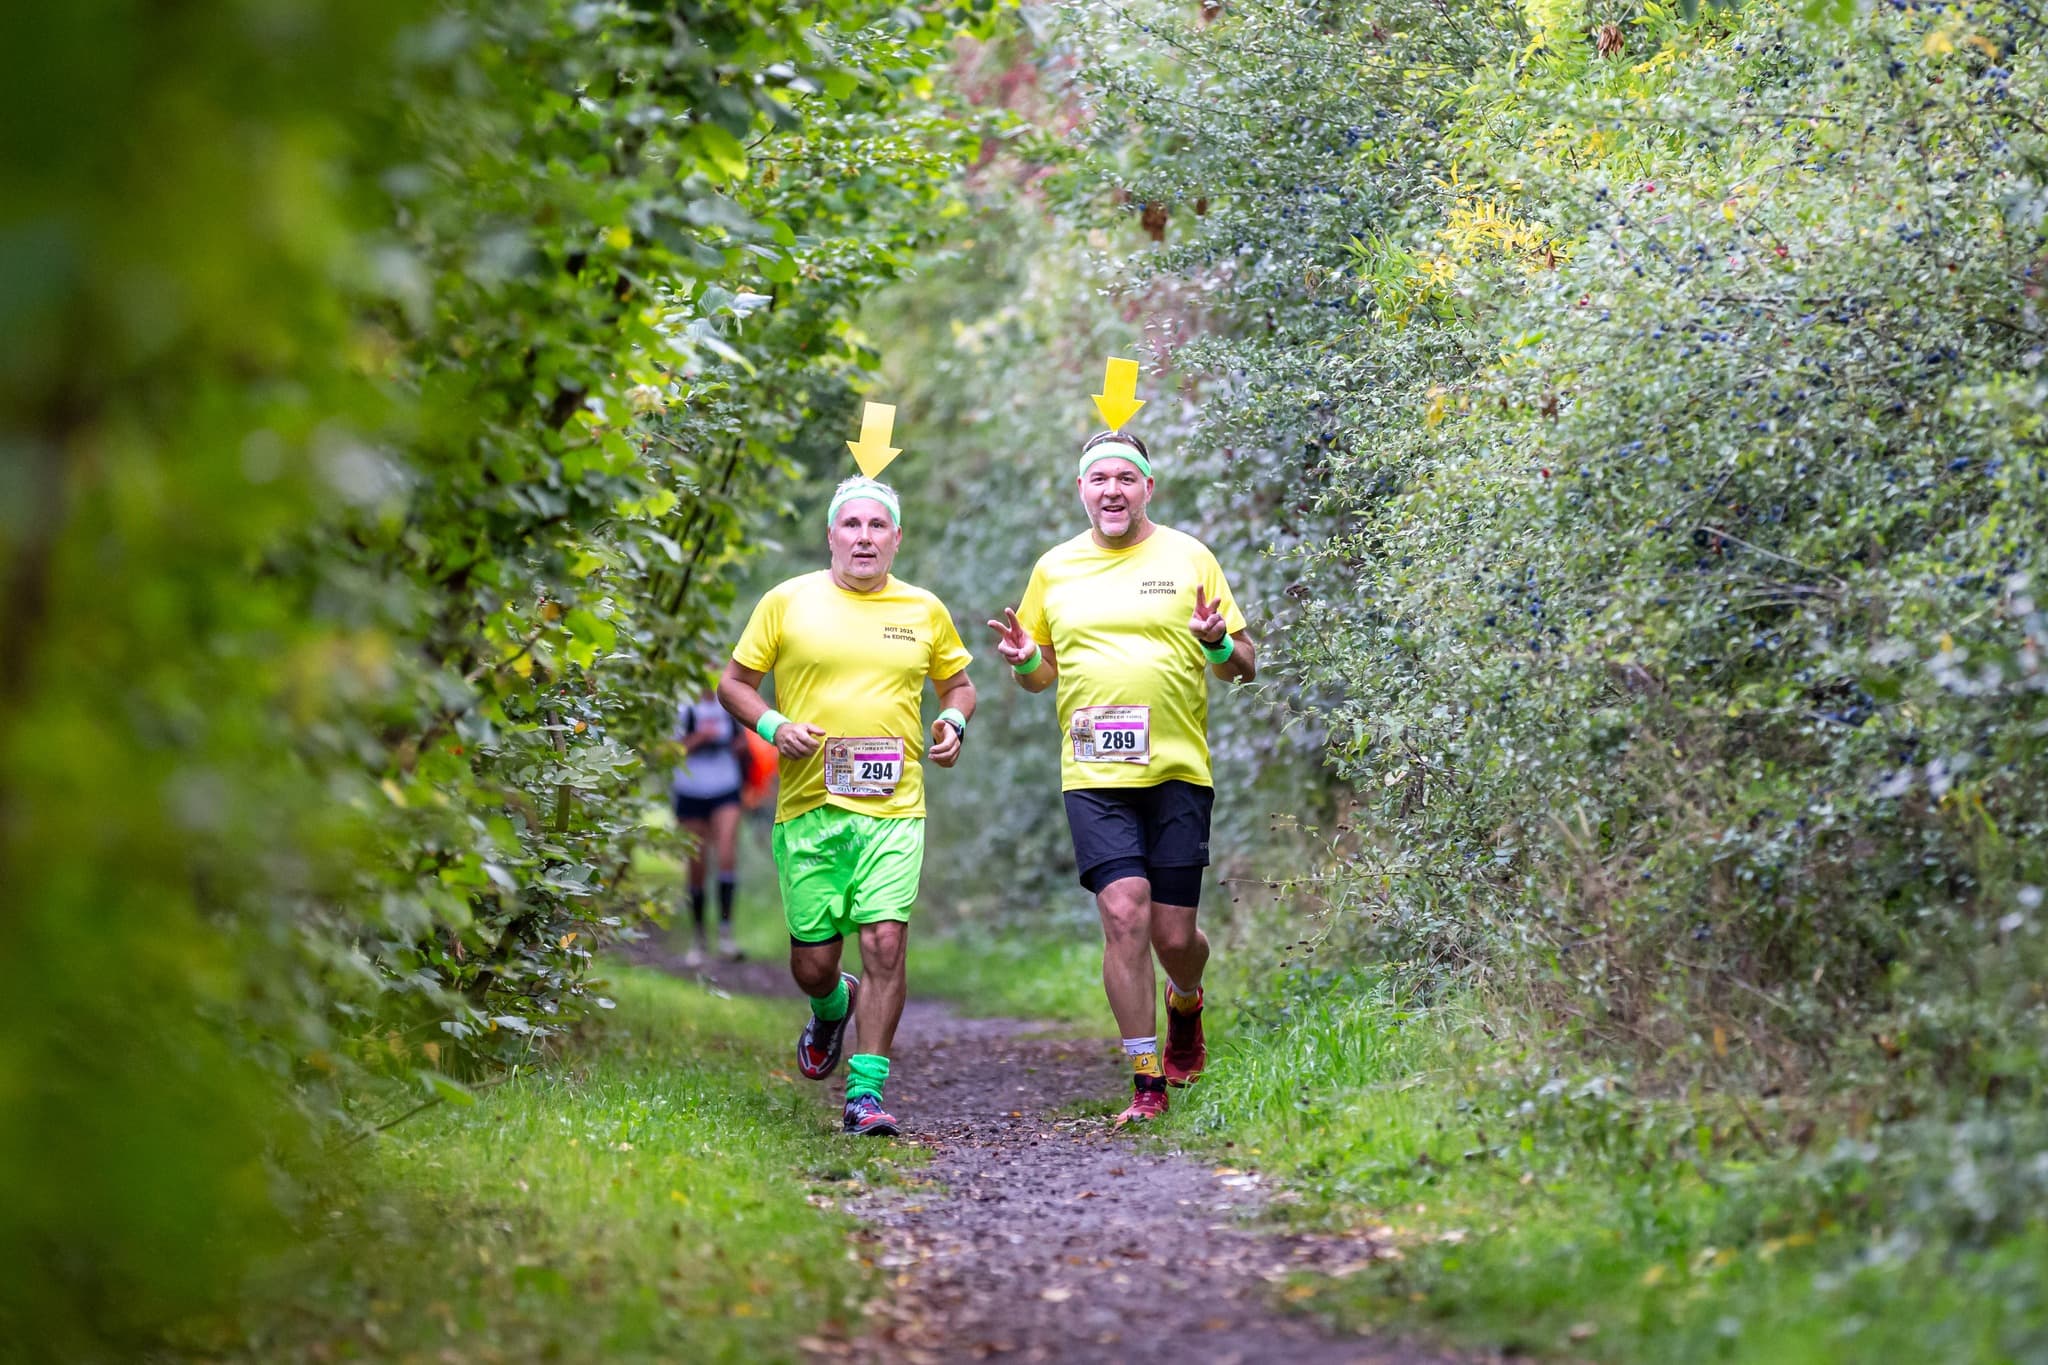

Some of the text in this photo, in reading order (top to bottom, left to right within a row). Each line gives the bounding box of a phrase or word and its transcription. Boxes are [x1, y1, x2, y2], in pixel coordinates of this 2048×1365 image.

[892, 634, 916, 642] EDITION
[1102, 731, 1136, 750] 289
[861, 762, 893, 780] 294
